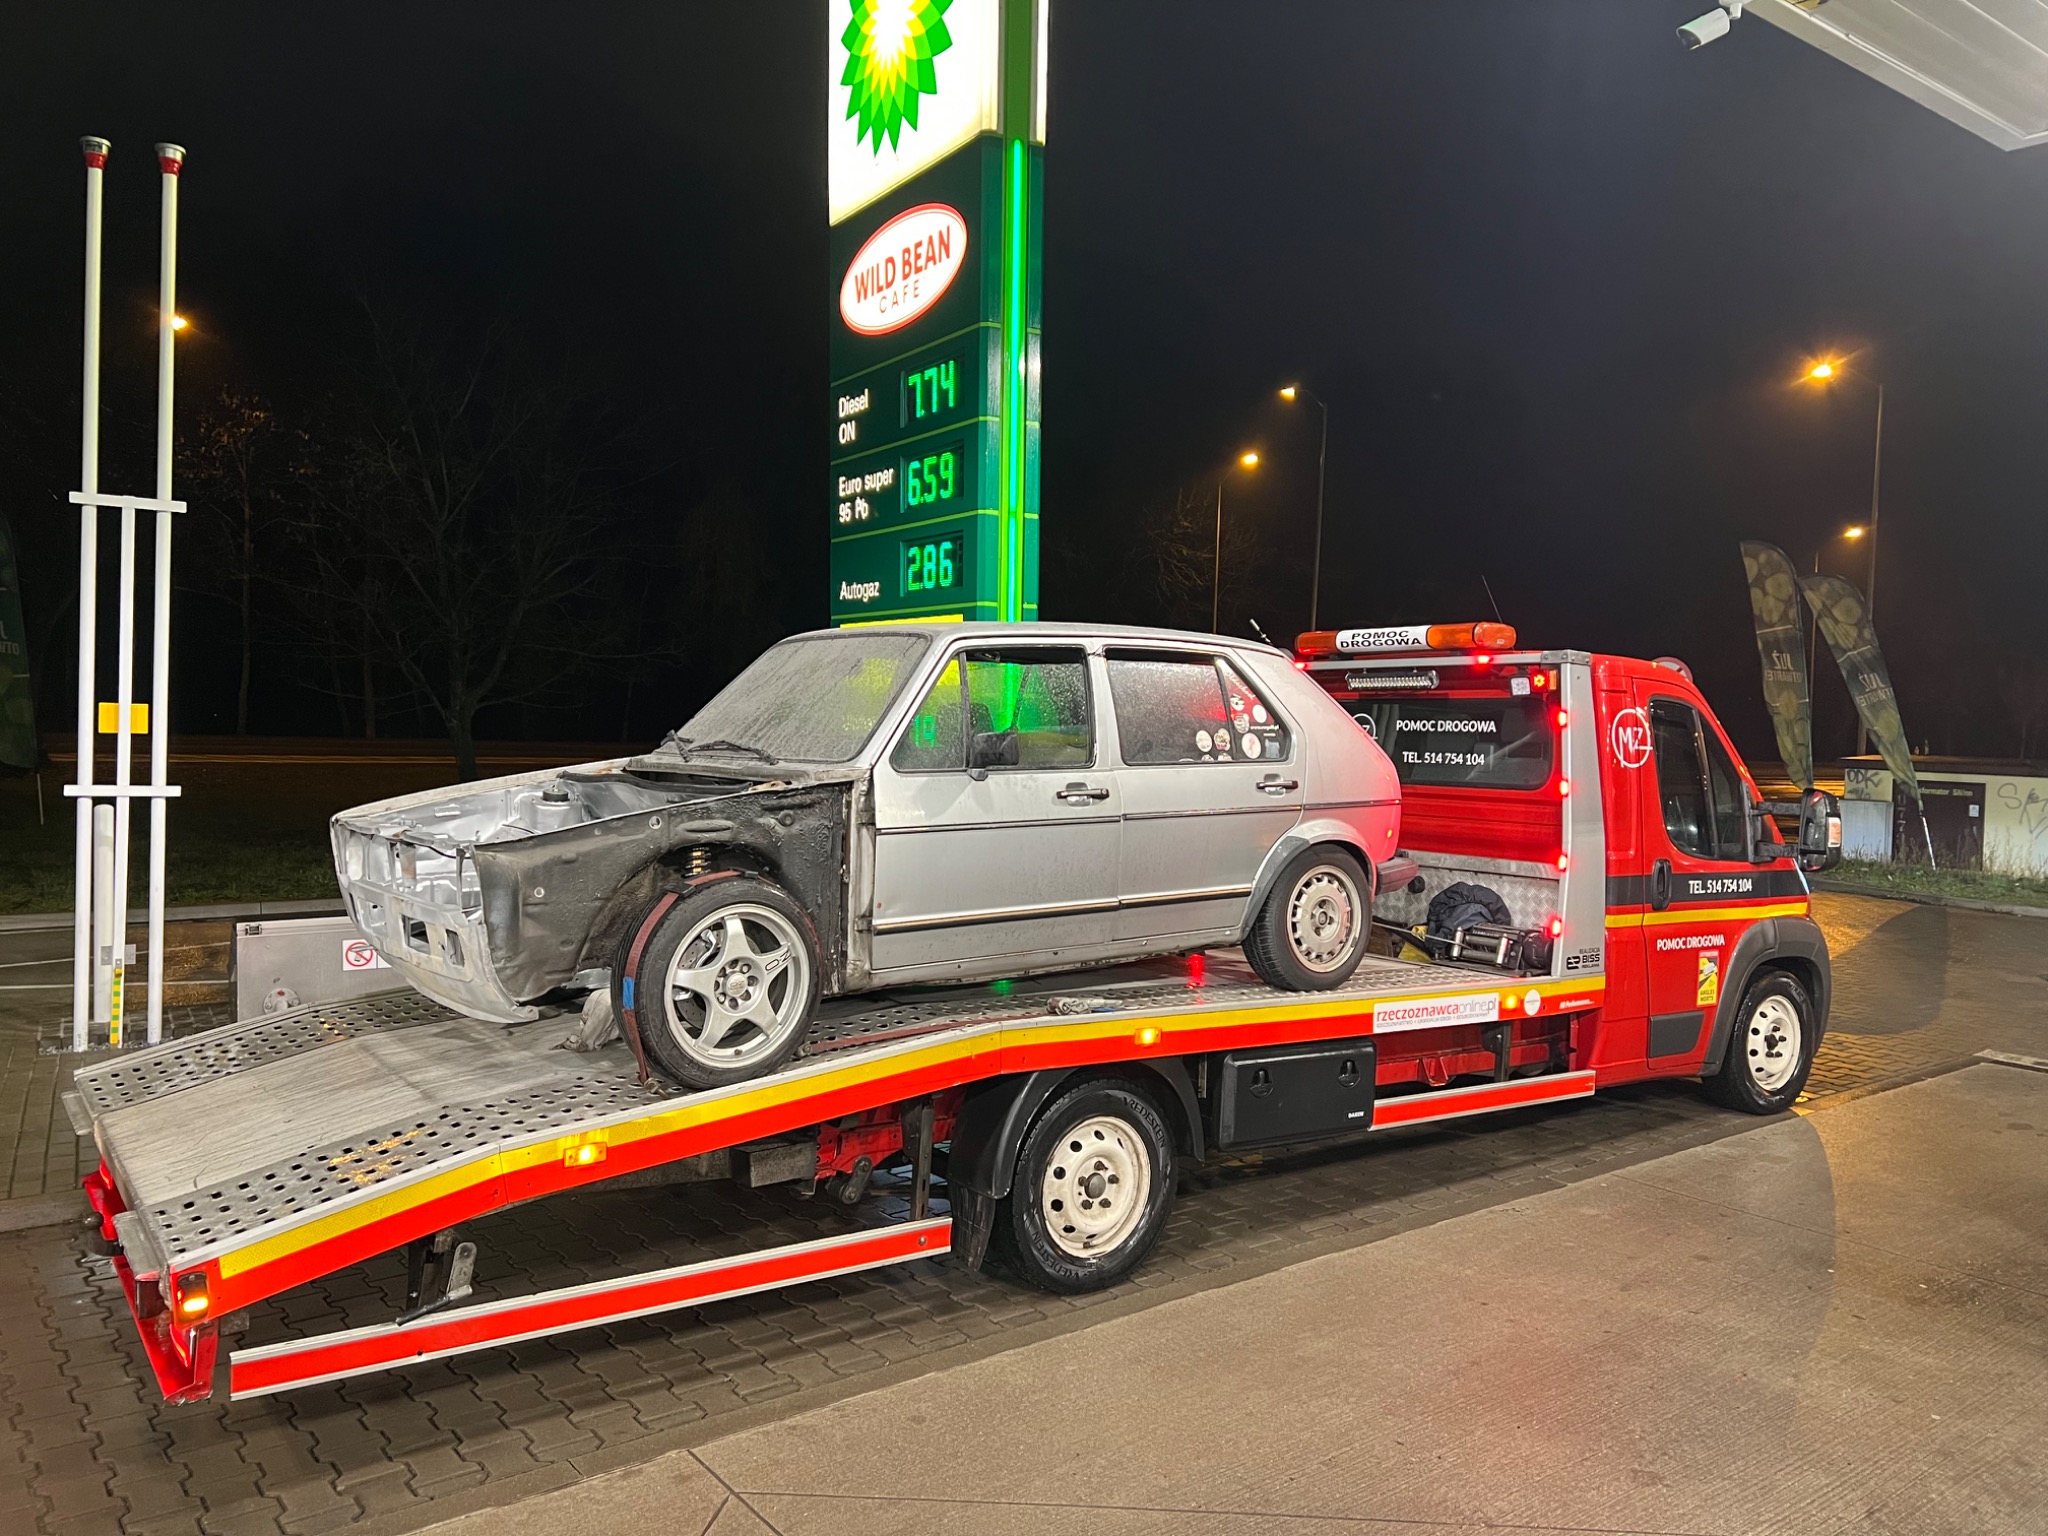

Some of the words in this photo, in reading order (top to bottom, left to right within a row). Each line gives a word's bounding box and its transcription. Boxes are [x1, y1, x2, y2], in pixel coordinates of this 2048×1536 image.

[854, 256, 896, 304] WILD
[901, 225, 951, 281] BEAN
[879, 279, 920, 313] CAFE
[908, 360, 955, 418] 7.74
[838, 388, 869, 418] Diesel
[838, 420, 856, 444] ON
[838, 475, 862, 497] Euro
[864, 468, 895, 491] super
[907, 452, 954, 506] 6.59
[838, 502, 851, 523] 95
[855, 496, 869, 520] Pb
[907, 541, 953, 591] 2.86
[839, 581, 881, 603] Autogaz
[1340, 637, 1422, 648] DROGOWA
[1351, 630, 1409, 640] POMOC
[1395, 719, 1436, 732] POMOC
[1437, 720, 1497, 733] DROGOWA
[1402, 751, 1422, 764] TEL.
[1423, 752, 1442, 764] 514
[1444, 753, 1463, 765] 754
[1465, 753, 1485, 765] 104
[1688, 880, 1705, 894] TEL.
[1706, 880, 1722, 893] 514
[1722, 879, 1737, 893] 754
[1738, 879, 1752, 892] 104
[1656, 937, 1687, 951] POMOC
[1687, 934, 1725, 949] DROGOWA
[1582, 953, 1600, 963] BISS
[1122, 1097, 1166, 1148] VREDESTEIN
